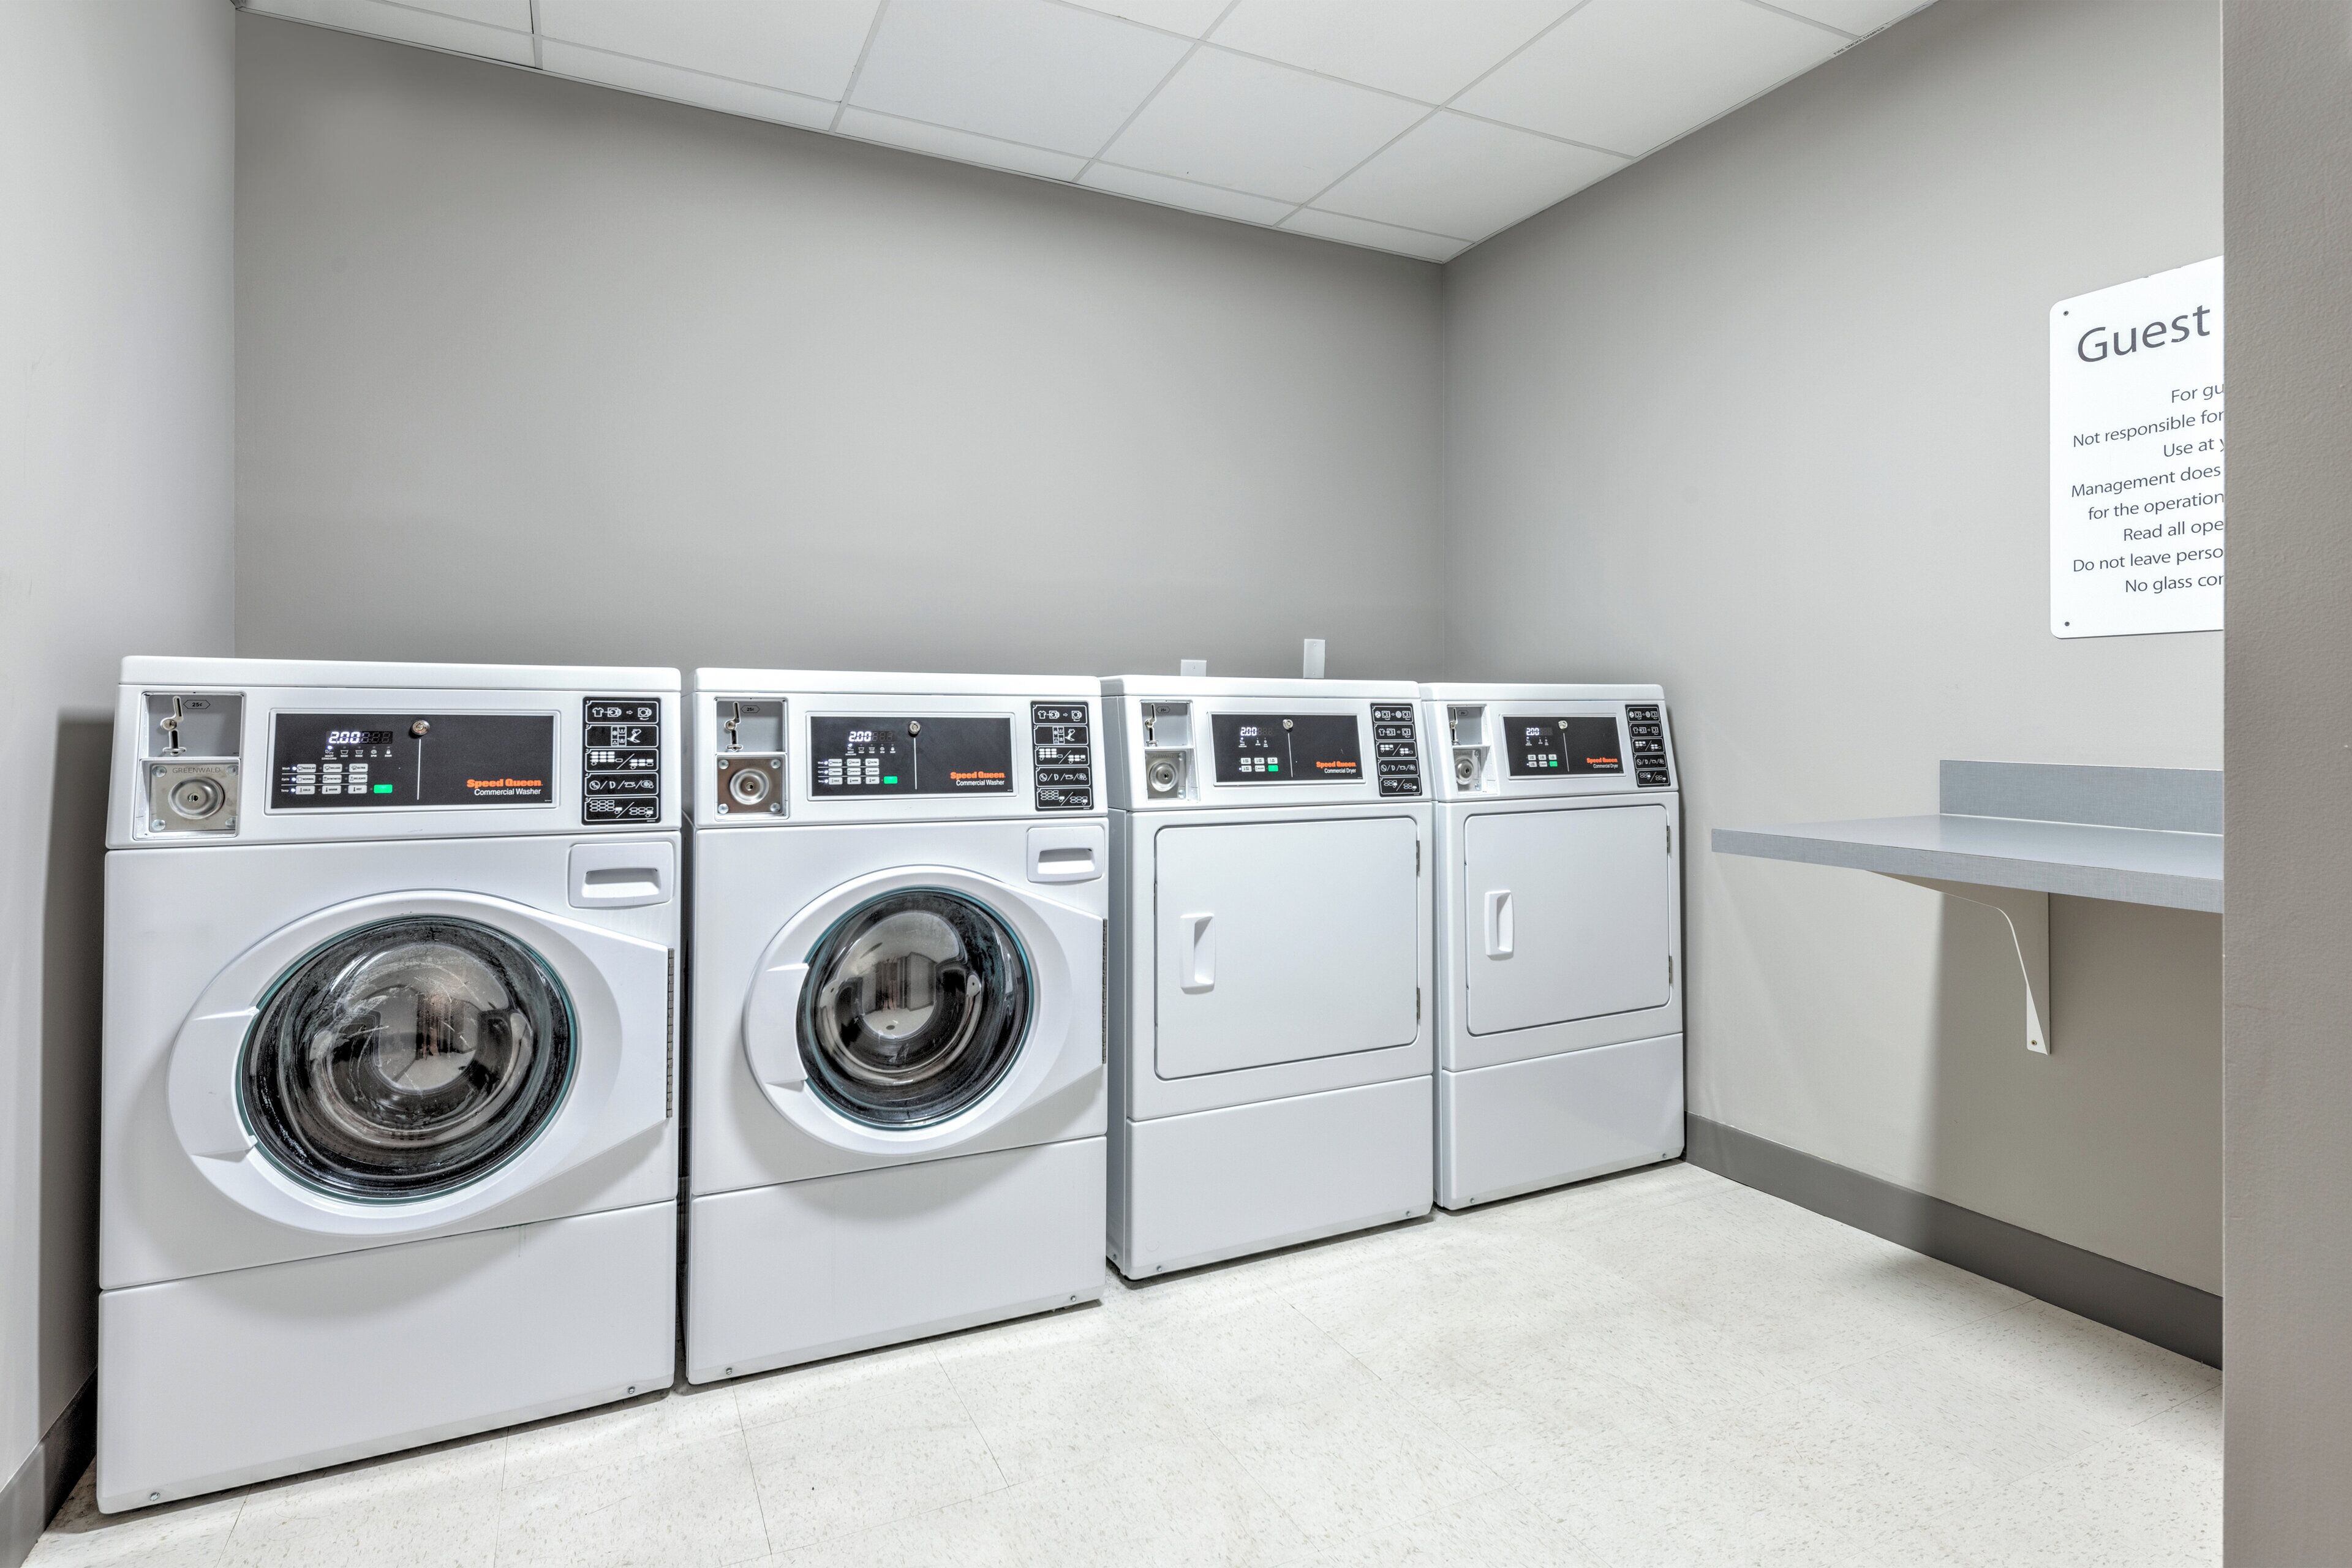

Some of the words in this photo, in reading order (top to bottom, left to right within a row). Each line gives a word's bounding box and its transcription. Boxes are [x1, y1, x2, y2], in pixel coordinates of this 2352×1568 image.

[2078, 305, 2210, 362] Guest
[2172, 390, 2198, 403] For
[2203, 384, 2223, 400] gu
[2074, 432, 2100, 447] Not
[2106, 414, 2195, 441] responsible
[2201, 410, 2223, 424] for
[2164, 443, 2193, 457] Use
[2199, 439, 2214, 451] at
[2072, 472, 2175, 497] Management
[2180, 466, 2220, 481] does
[2089, 507, 2109, 519] for
[2114, 503, 2139, 516] the
[2144, 493, 2223, 514] operation
[2124, 524, 2162, 541] Read
[2168, 521, 2184, 536] all
[2192, 521, 2223, 535] ope
[2074, 560, 2094, 571] Do
[2100, 556, 2125, 569] not
[2131, 553, 2170, 566] leave
[2177, 548, 2223, 565] perso
[2126, 579, 2147, 592] No
[2153, 576, 2192, 594] glass
[329, 731, 360, 744] 2.00
[848, 731, 872, 742] 2.00
[1240, 727, 1257, 736] 2.00
[466, 778, 503, 789] Speed
